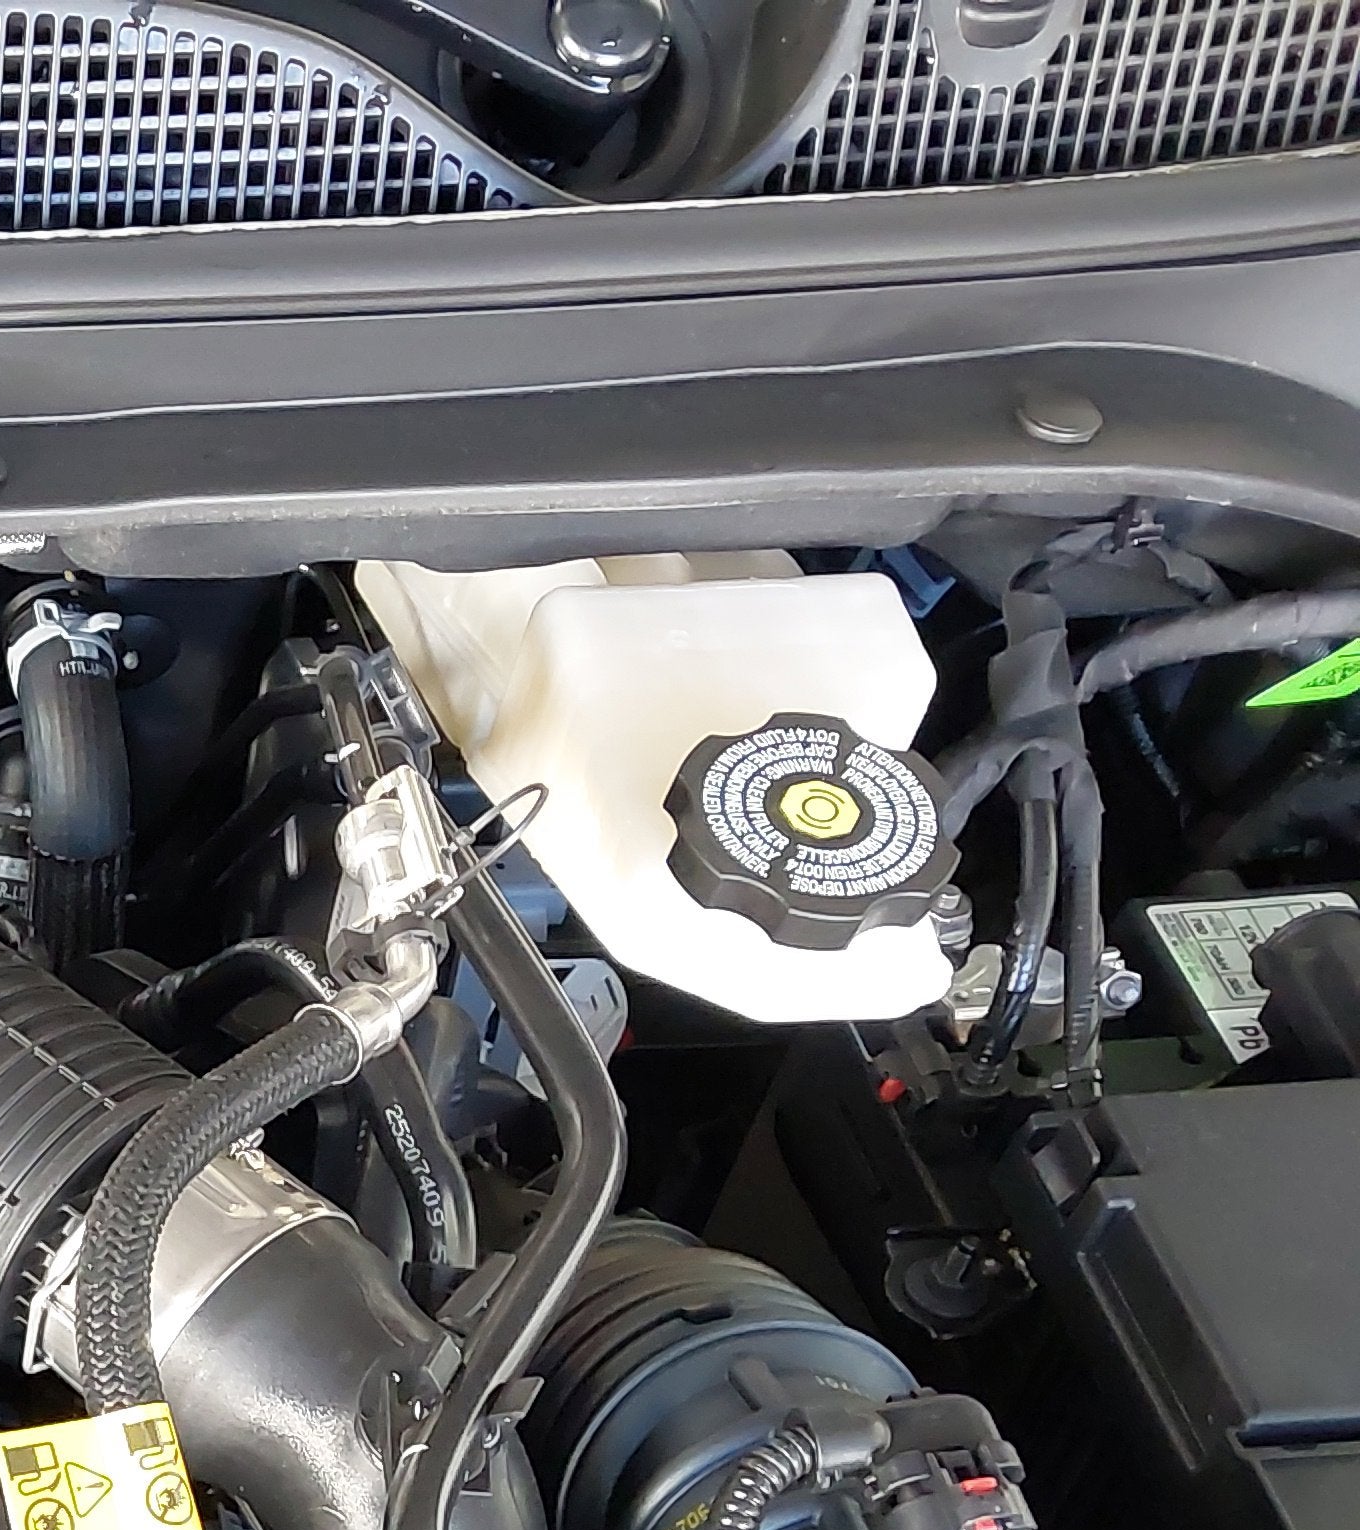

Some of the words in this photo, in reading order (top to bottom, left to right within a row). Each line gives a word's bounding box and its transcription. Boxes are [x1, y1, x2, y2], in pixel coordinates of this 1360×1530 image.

[753, 728, 798, 751] FLUID
[804, 743, 837, 759] CAP
[718, 739, 764, 771] FROM
[749, 743, 805, 771] BEFORE
[703, 770, 733, 814] SEALED
[745, 776, 771, 812] CLEAN
[726, 812, 754, 836] USE
[748, 812, 789, 850] FILLER
[742, 833, 781, 861] ONLY
[824, 863, 865, 880] FREIN
[845, 874, 888, 896] AVANT
[1230, 1025, 1266, 1049] Pb
[384, 1103, 447, 1228] 25207409
